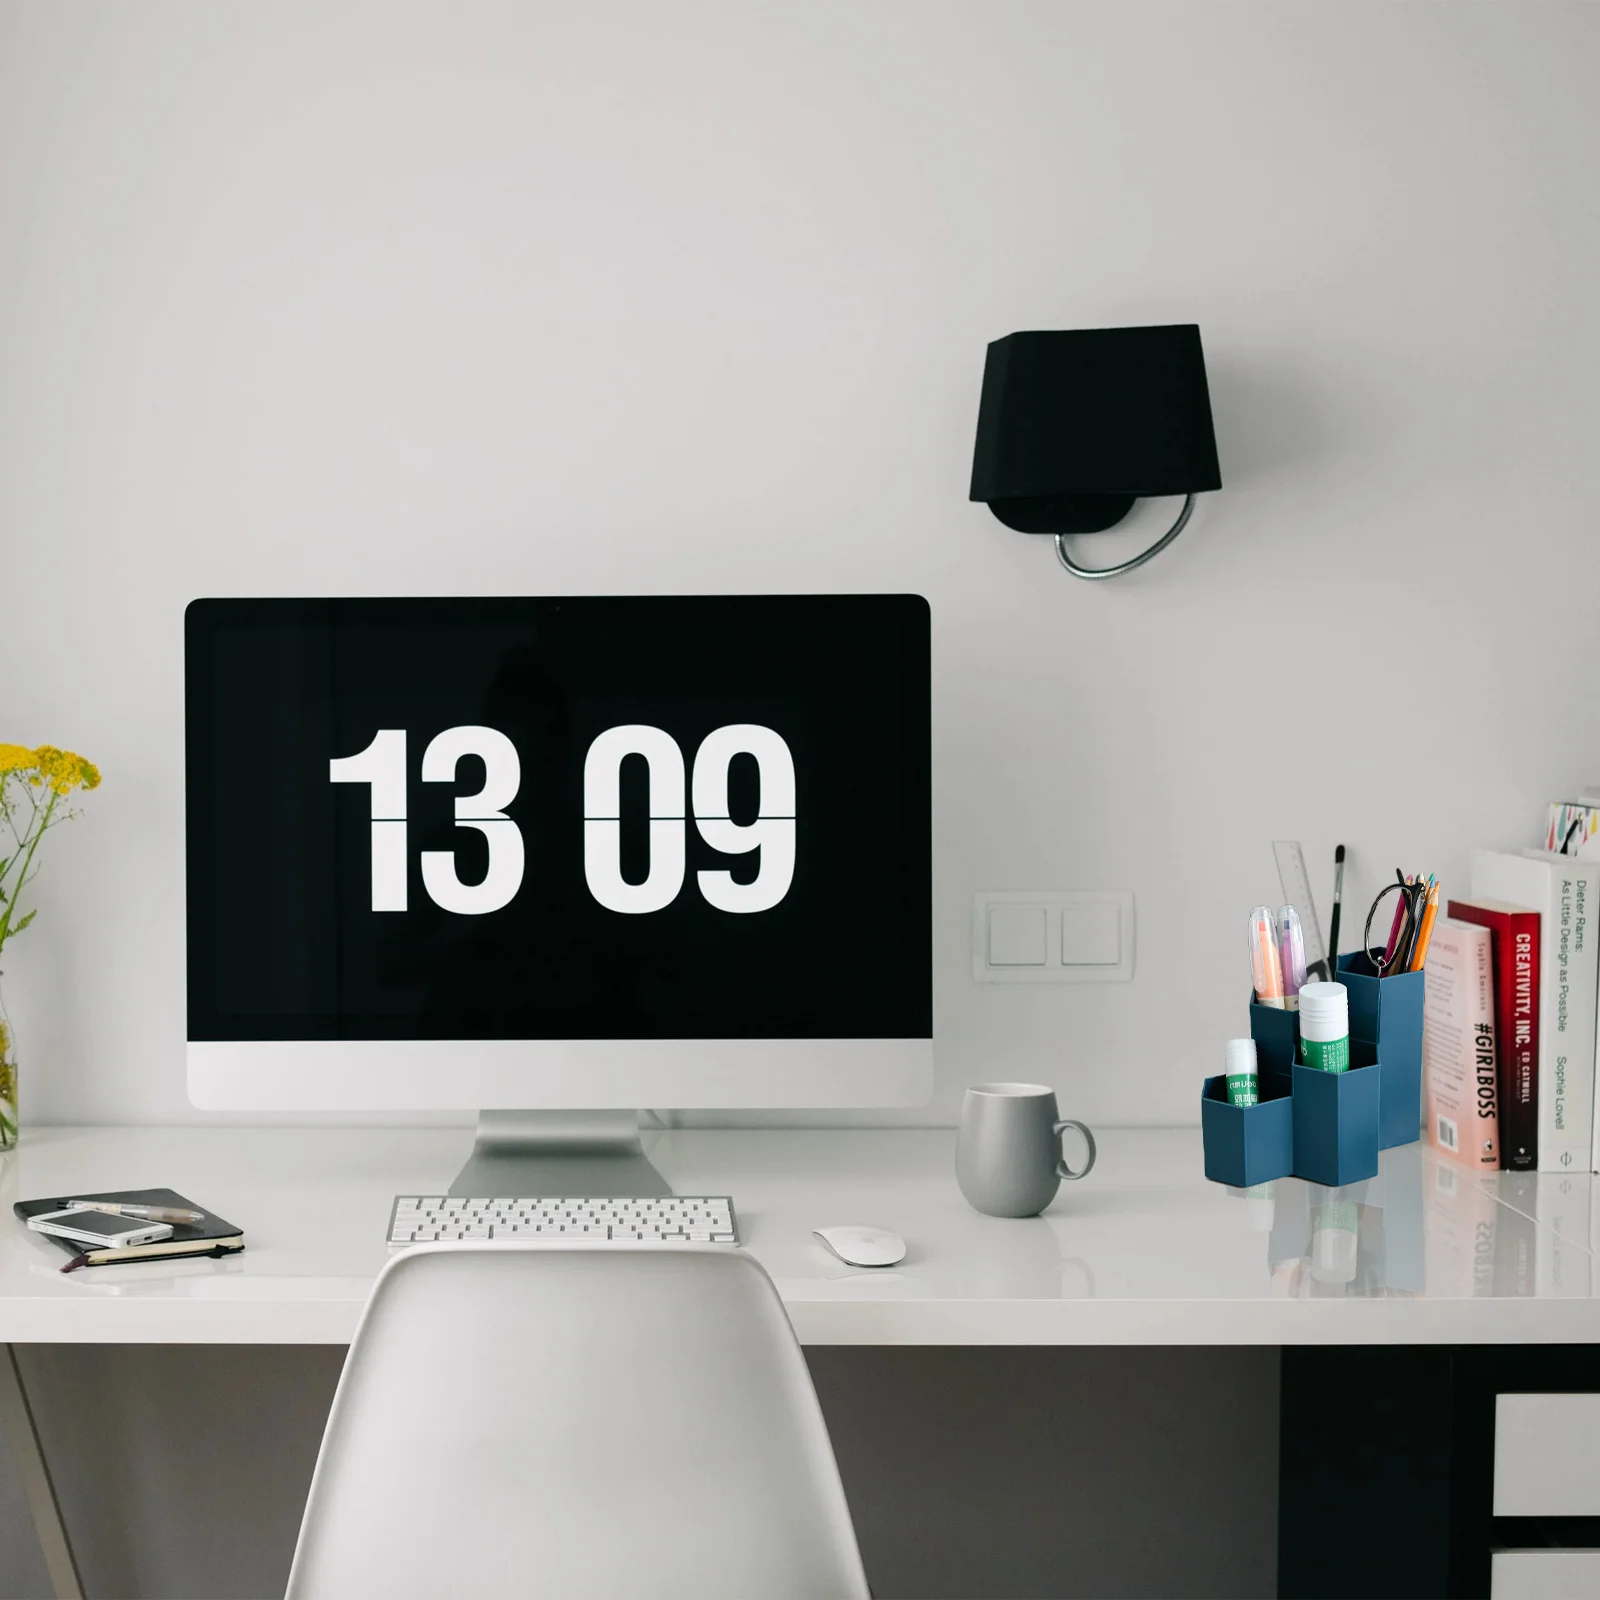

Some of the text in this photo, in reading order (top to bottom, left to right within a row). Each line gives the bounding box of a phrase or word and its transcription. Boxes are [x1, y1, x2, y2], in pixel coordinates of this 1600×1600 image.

[330, 723, 796, 915] 13 09
[1557, 880, 1571, 1032] As Little Design as Possible
[1575, 880, 1587, 952] Dieter Rams:
[1514, 933, 1531, 1048] CREATIVITY, INC.
[1474, 1023, 1496, 1119] #GIRLBOSS
[1521, 1051, 1530, 1104] ED CATMULL
[1555, 1056, 1567, 1130] Sophie Lovell
